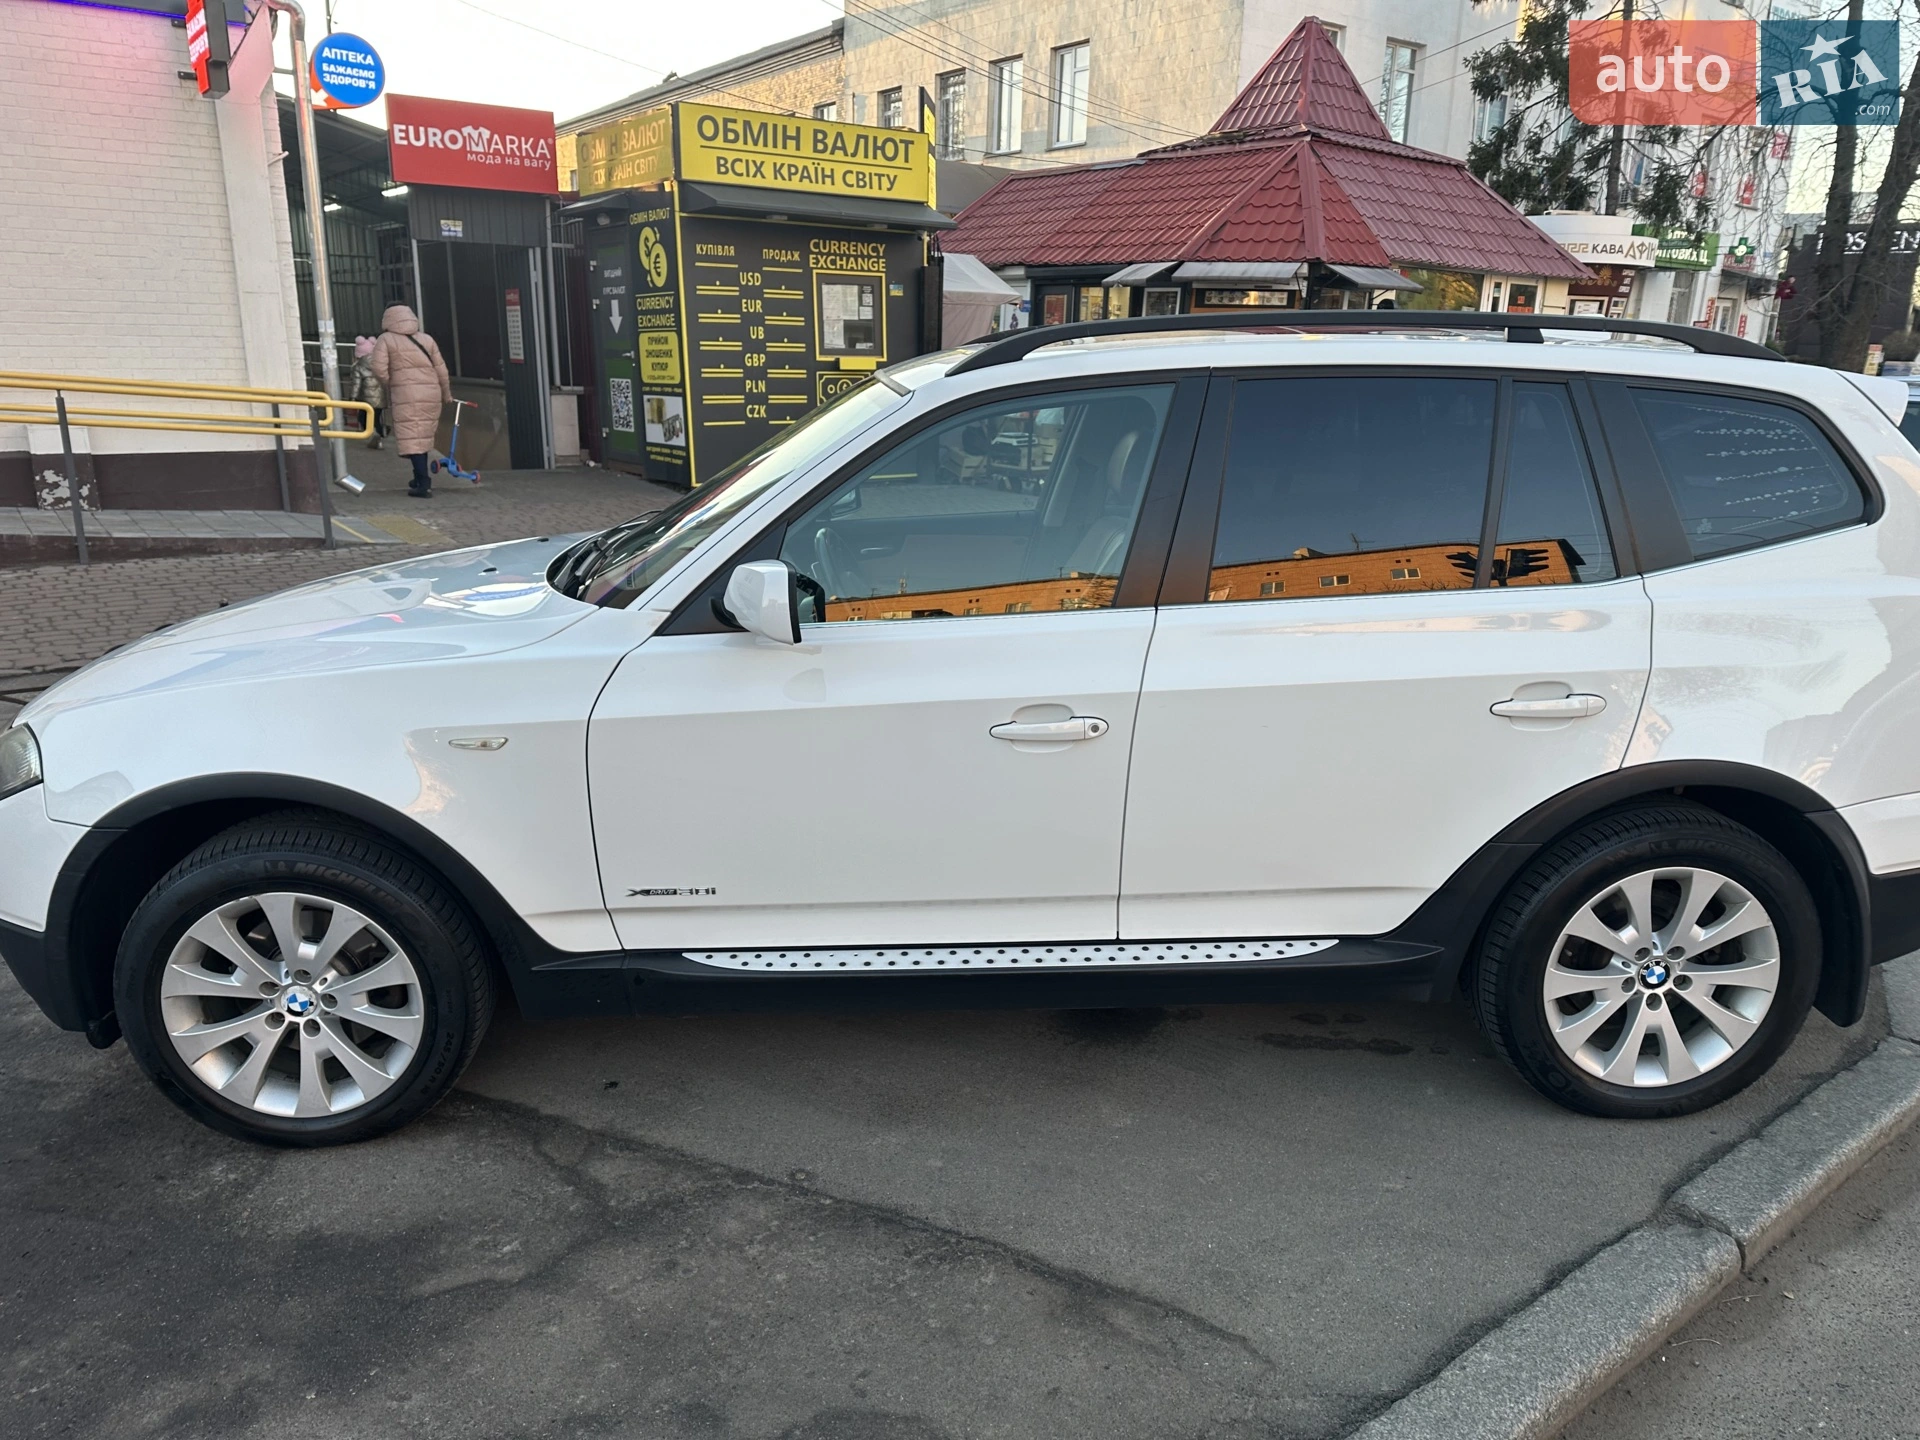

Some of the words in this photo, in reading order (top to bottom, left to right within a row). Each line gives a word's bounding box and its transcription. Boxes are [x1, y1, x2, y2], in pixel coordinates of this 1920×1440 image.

[322, 46, 375, 66] АПТЕКА
[322, 62, 376, 79] БАЖАЄМО
[322, 73, 376, 90] ЗДОРОВ'Я
[622, 118, 666, 152] ВАЛЮТ
[697, 114, 801, 151] ОБМІН
[812, 128, 915, 163] ВАЛЮТ
[467, 153, 501, 165] мода
[505, 157, 520, 166] на
[524, 159, 551, 170] вагу
[635, 155, 658, 175] СВІТУ
[716, 156, 766, 180] ВСІХ
[773, 161, 835, 185] КРАЇН
[842, 169, 898, 191] СВІТУ
[629, 209, 647, 225] ОБМІН
[649, 207, 670, 221] ВАЛЮТ
[695, 243, 735, 256] КУПІВЛЯ
[809, 239, 886, 256] CURRENCY
[1591, 243, 1624, 255] КАВА
[762, 249, 800, 263] ПРОДАЖ
[809, 254, 886, 271] EXCHANGE
[739, 272, 762, 286] USD
[636, 296, 674, 310] CURRENCY
[741, 299, 763, 313] EUR
[637, 314, 675, 327] EXCHANGE
[750, 326, 764, 340] UB
[744, 353, 766, 367] GBP
[745, 380, 766, 393] PLN
[746, 405, 767, 418] CZK
